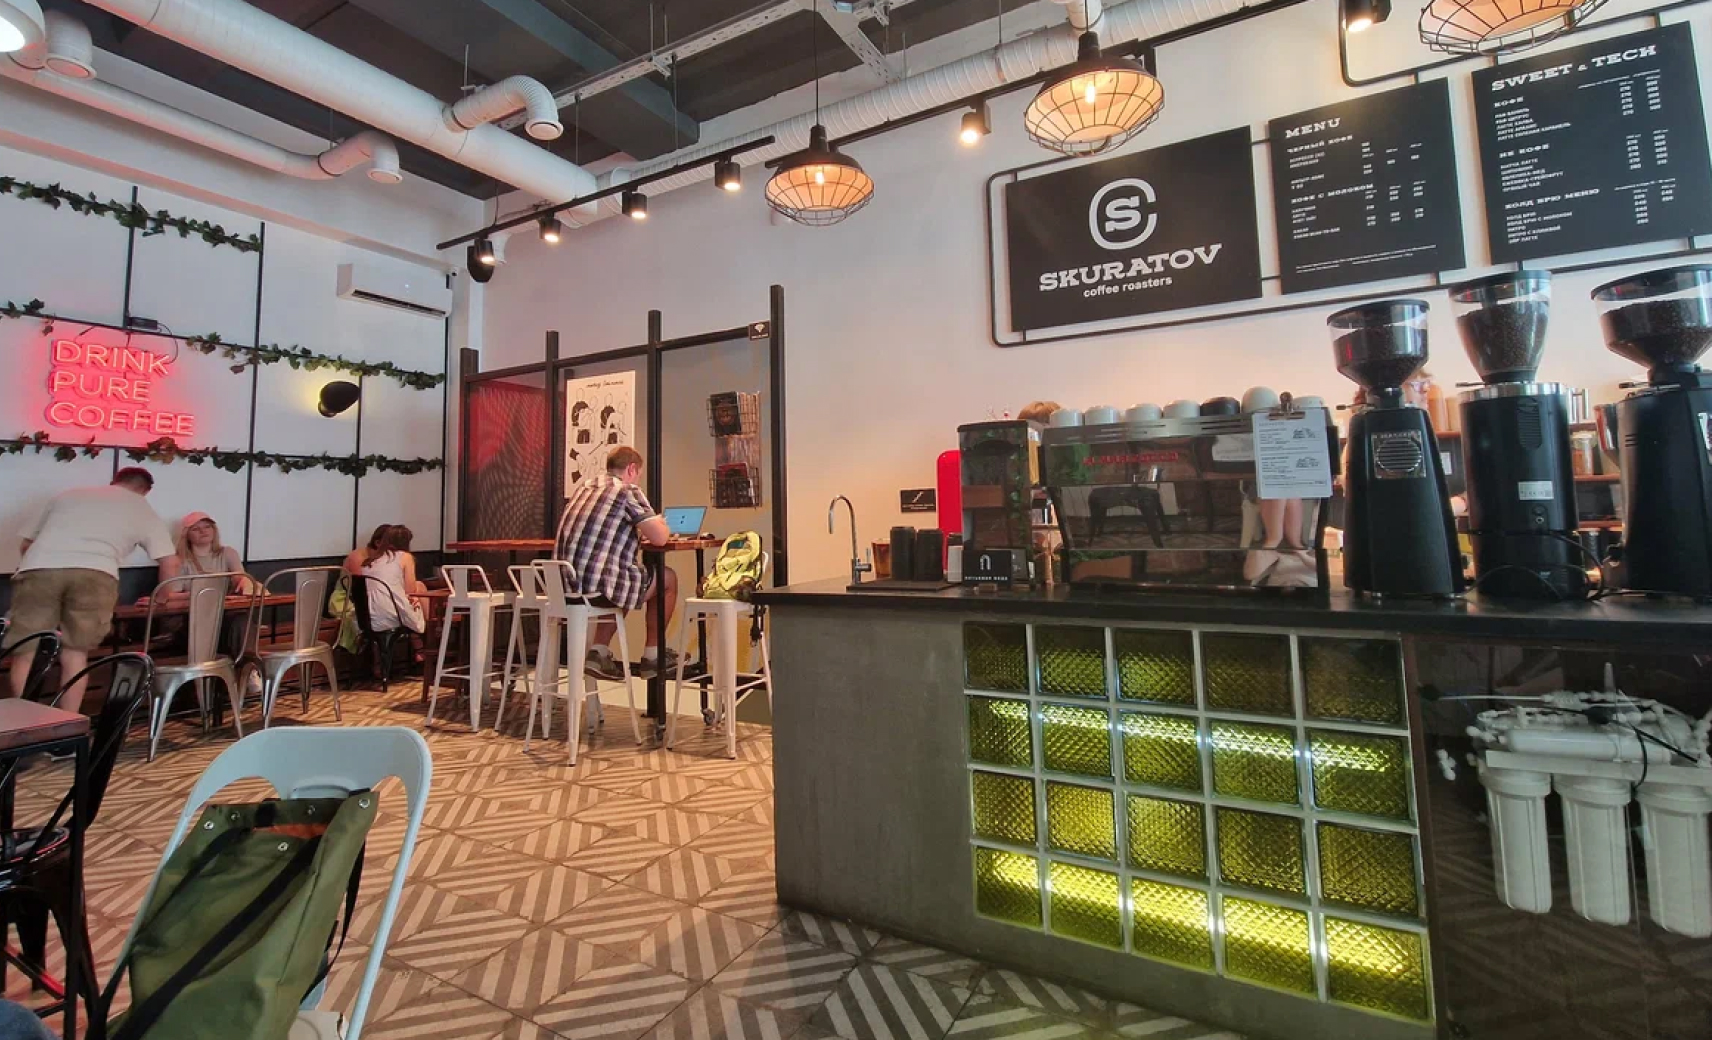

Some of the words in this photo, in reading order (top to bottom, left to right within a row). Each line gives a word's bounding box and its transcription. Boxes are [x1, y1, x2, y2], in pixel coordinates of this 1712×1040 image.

[1491, 64, 1573, 91] SWEET
[1591, 45, 1657, 67] TECH
[1285, 117, 1341, 139] MENU
[1039, 242, 1223, 292] SKURATOV
[1083, 283, 1120, 298] coffee
[1122, 276, 1173, 292] roasters
[56, 340, 170, 375] DRINK
[53, 371, 151, 402] PURE
[50, 402, 194, 436] COFFEE
